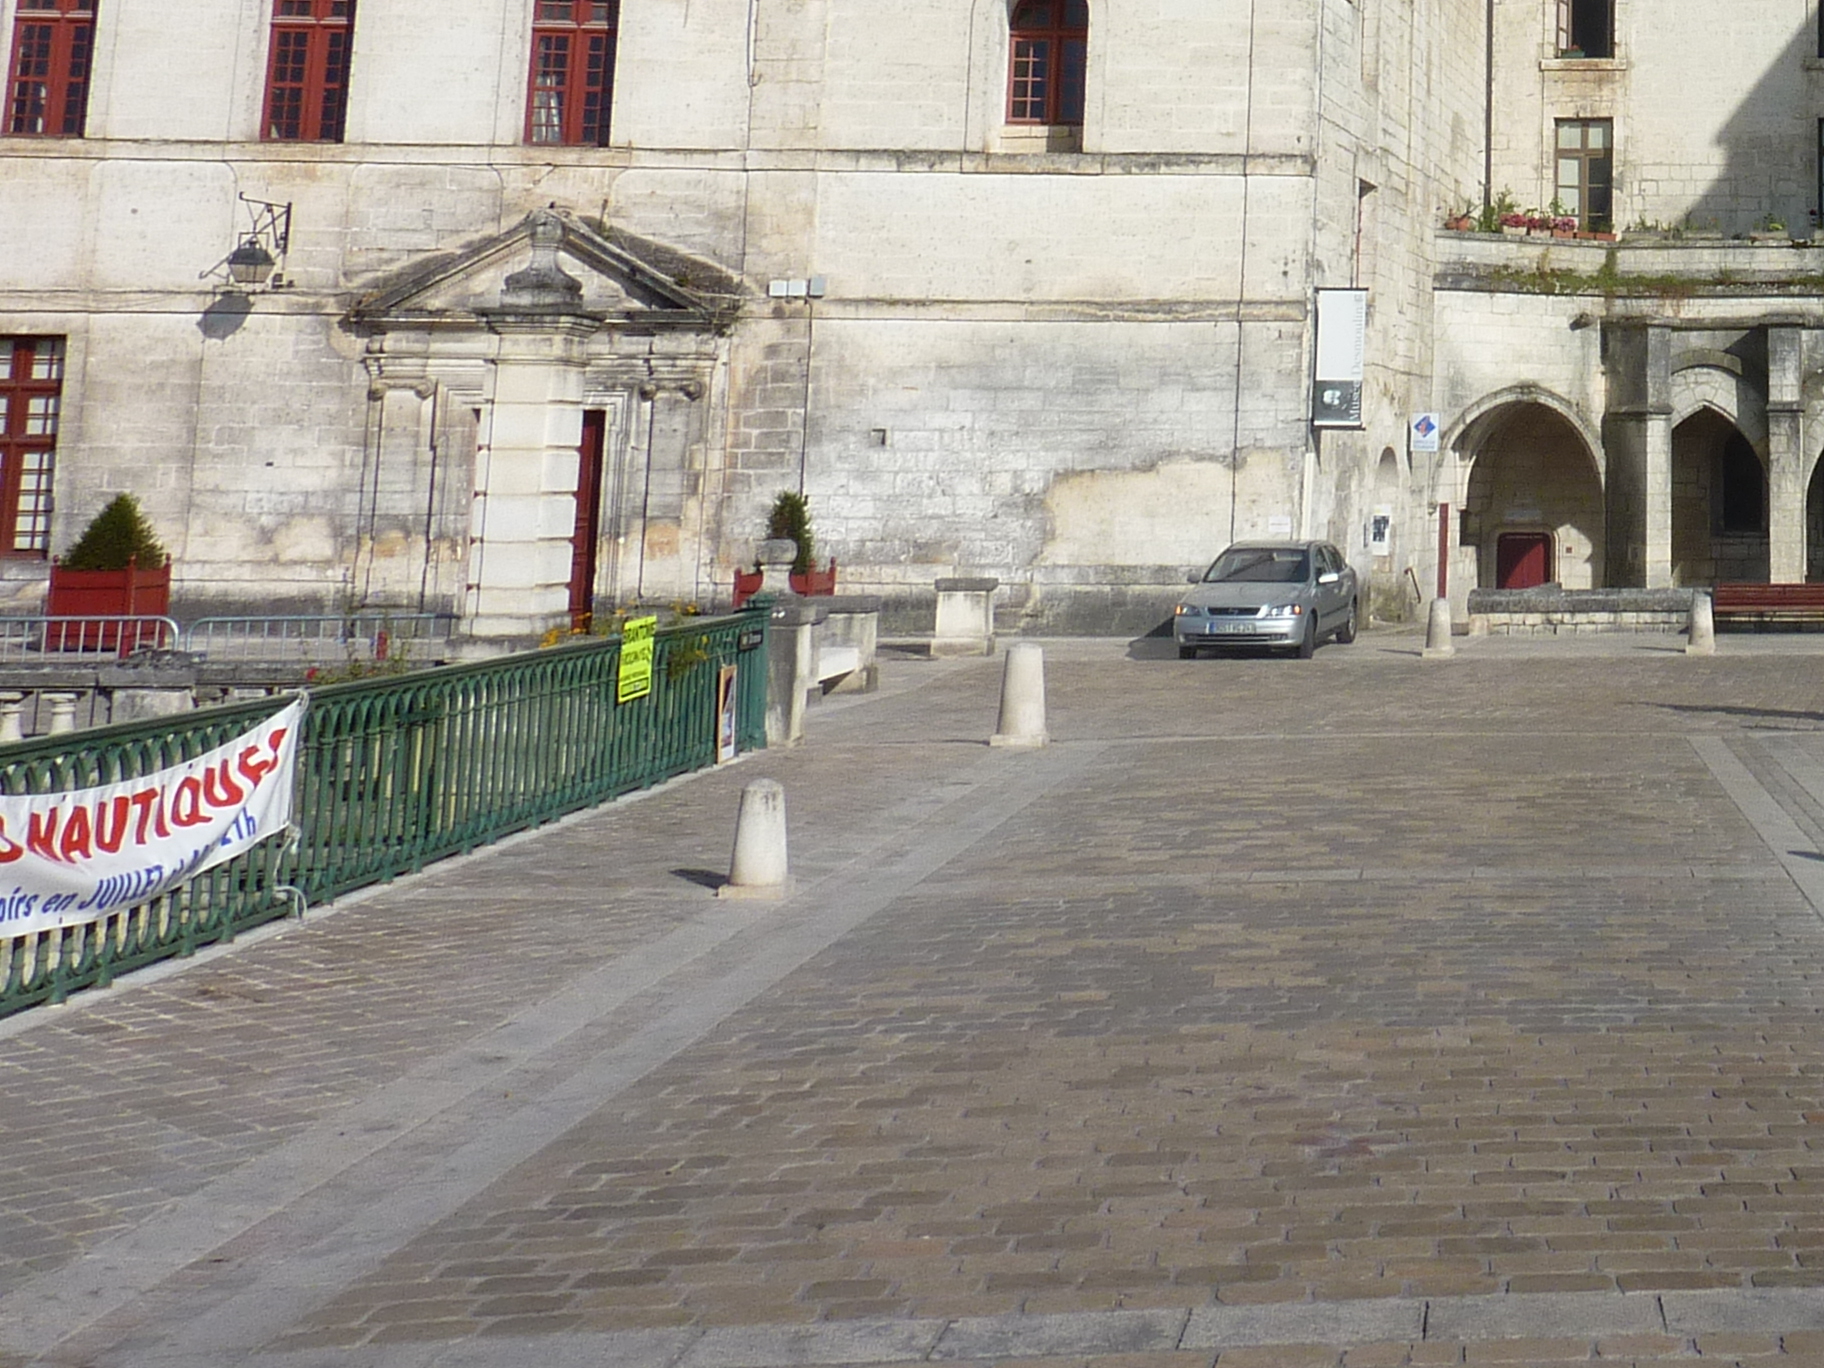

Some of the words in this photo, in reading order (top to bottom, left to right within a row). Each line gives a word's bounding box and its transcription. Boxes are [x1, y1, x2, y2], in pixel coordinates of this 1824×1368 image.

[1351, 306, 1364, 376] Desmoulin
[26, 727, 288, 865] NAUTIQUES
[42, 893, 78, 913] en
[77, 864, 164, 910] JUILLET
